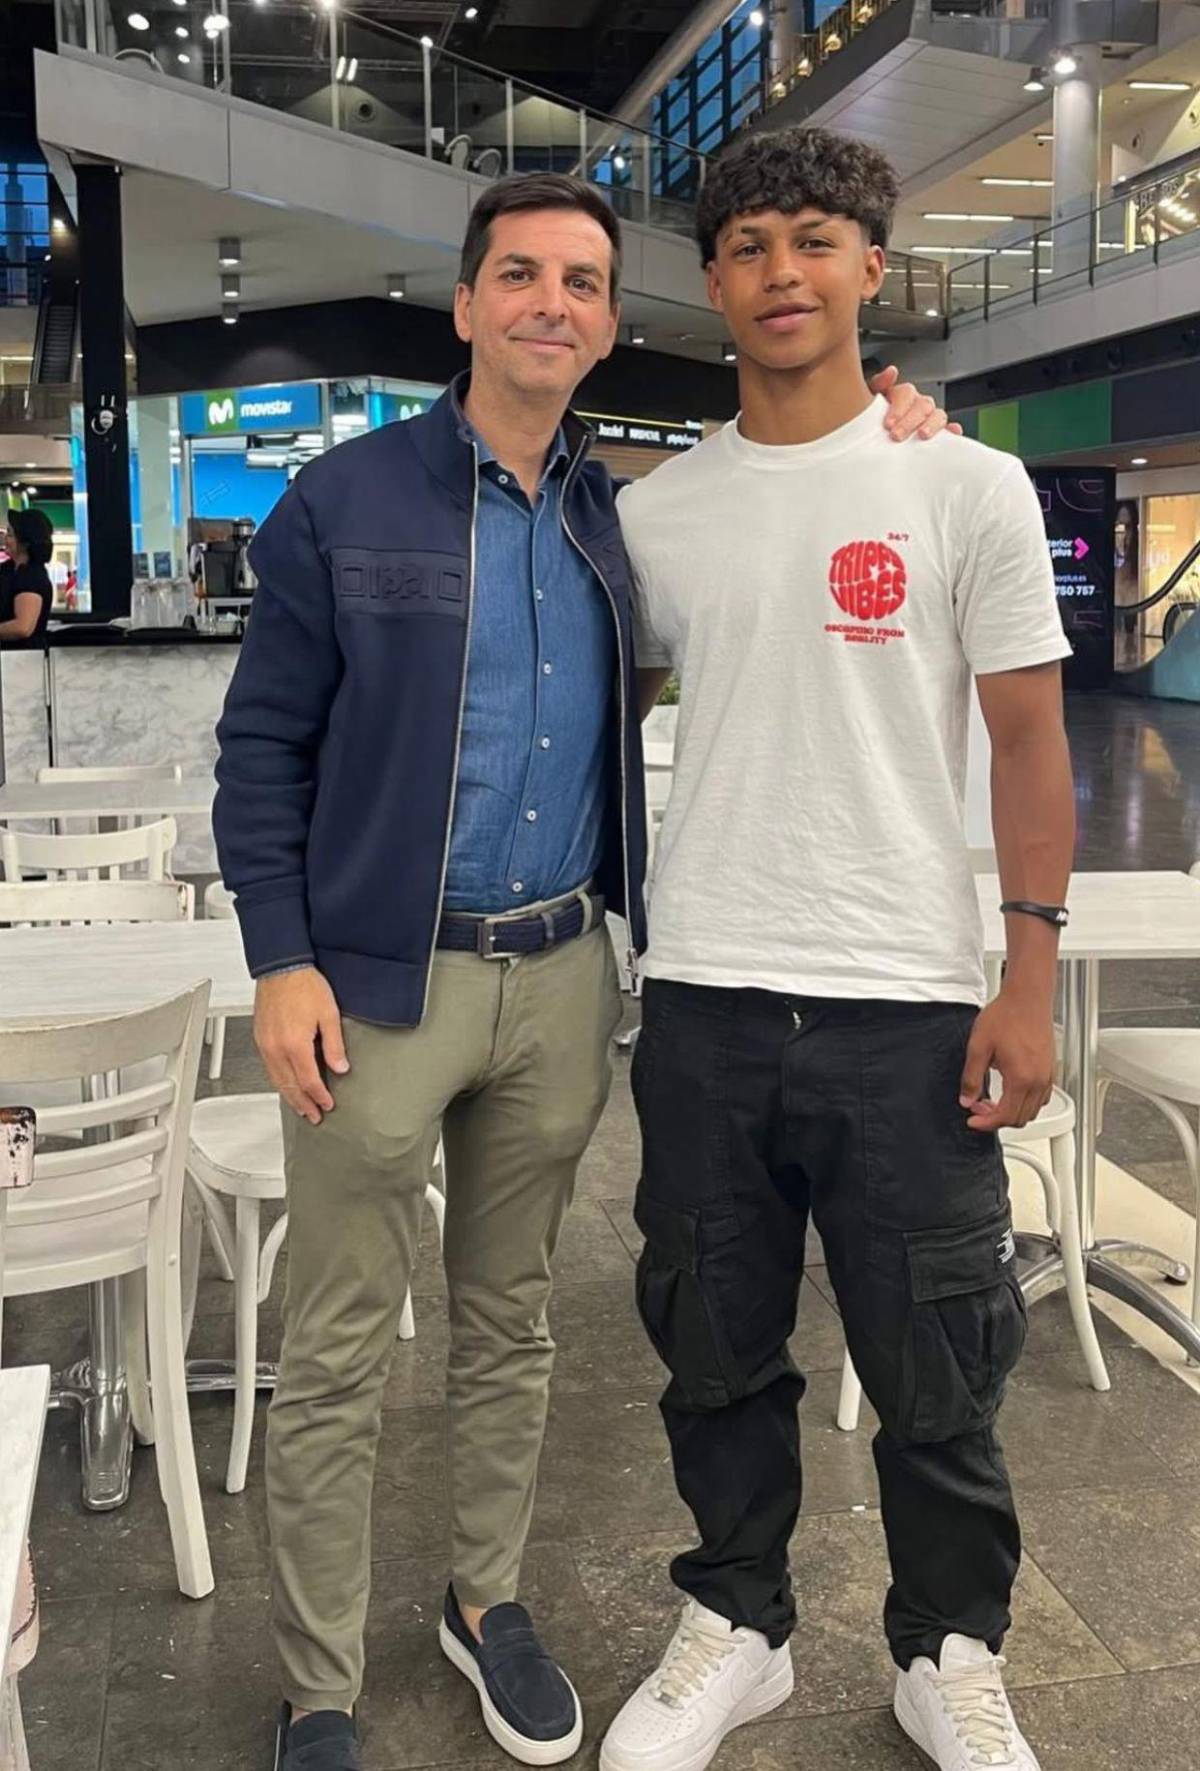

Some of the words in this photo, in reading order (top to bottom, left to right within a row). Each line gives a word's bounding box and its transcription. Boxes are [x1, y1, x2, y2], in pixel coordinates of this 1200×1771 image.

[240, 400, 292, 417] movistar
[1051, 548, 1072, 559] plus
[829, 570, 906, 620] VIBES
